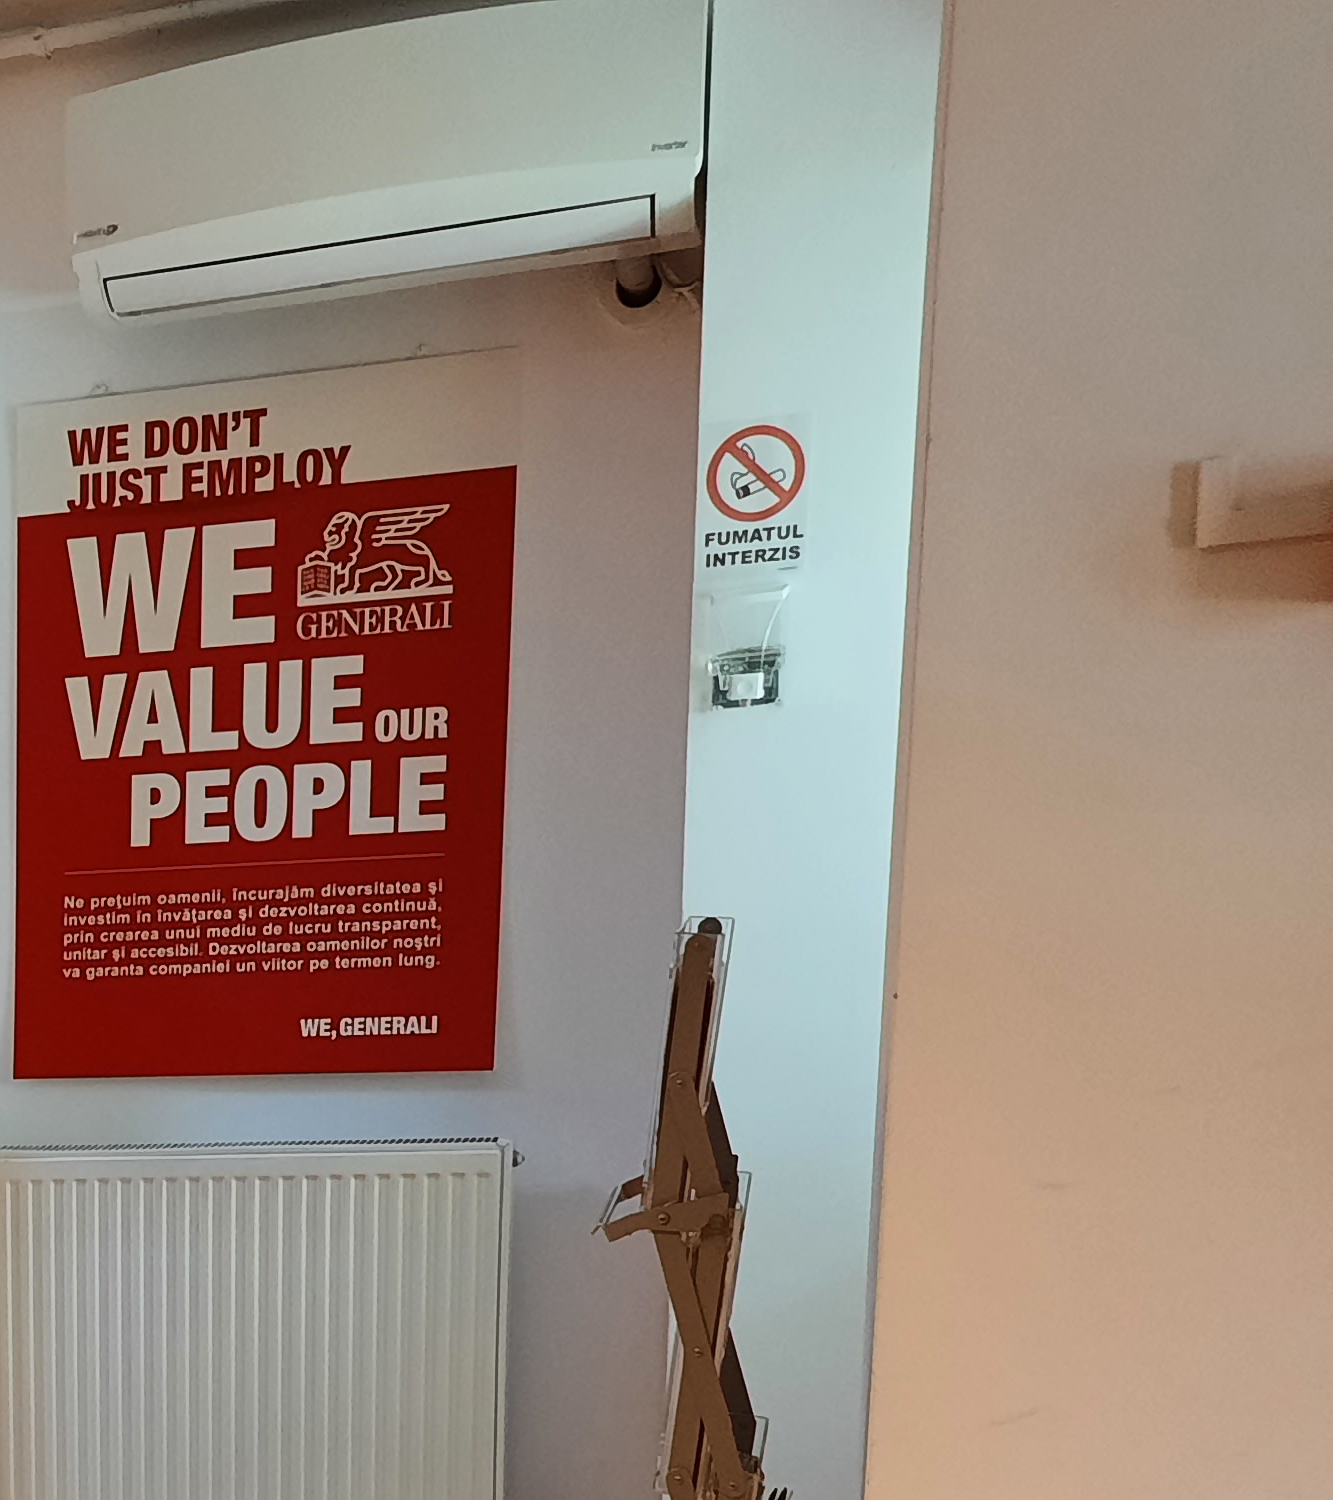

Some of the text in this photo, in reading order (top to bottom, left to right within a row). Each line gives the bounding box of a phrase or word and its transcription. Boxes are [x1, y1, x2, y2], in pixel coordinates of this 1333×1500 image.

[66, 407, 269, 467] WE DON'T
[66, 444, 353, 513] JUST EMPLOY
[704, 524, 805, 548] FUMATUL
[705, 545, 801, 569] INTERZIS
[66, 518, 276, 659] WE
[295, 600, 453, 641] GENERALI
[64, 654, 449, 761] VALUE OUR
[130, 754, 448, 848] PEOPLE
[63, 895, 85, 910] Ne
[156, 888, 227, 906] oamenii,
[232, 885, 315, 902] încurajăm
[320, 880, 422, 898] diversitatea
[63, 911, 131, 927] investim
[136, 909, 152, 924] în
[258, 901, 356, 919] dezvoltarea
[361, 896, 443, 914] continuă,
[62, 915, 442, 948] prin crearea unui mediu de lucru transparent,
[62, 947, 108, 961] unitar
[129, 942, 204, 959] accesibil.
[208, 939, 301, 956] Dezvoltarea
[306, 935, 389, 953] oamenilor
[61, 952, 441, 981] va garanta companiei un viitor pe termen lung.
[299, 1015, 439, 1041] WE, GENERALI
